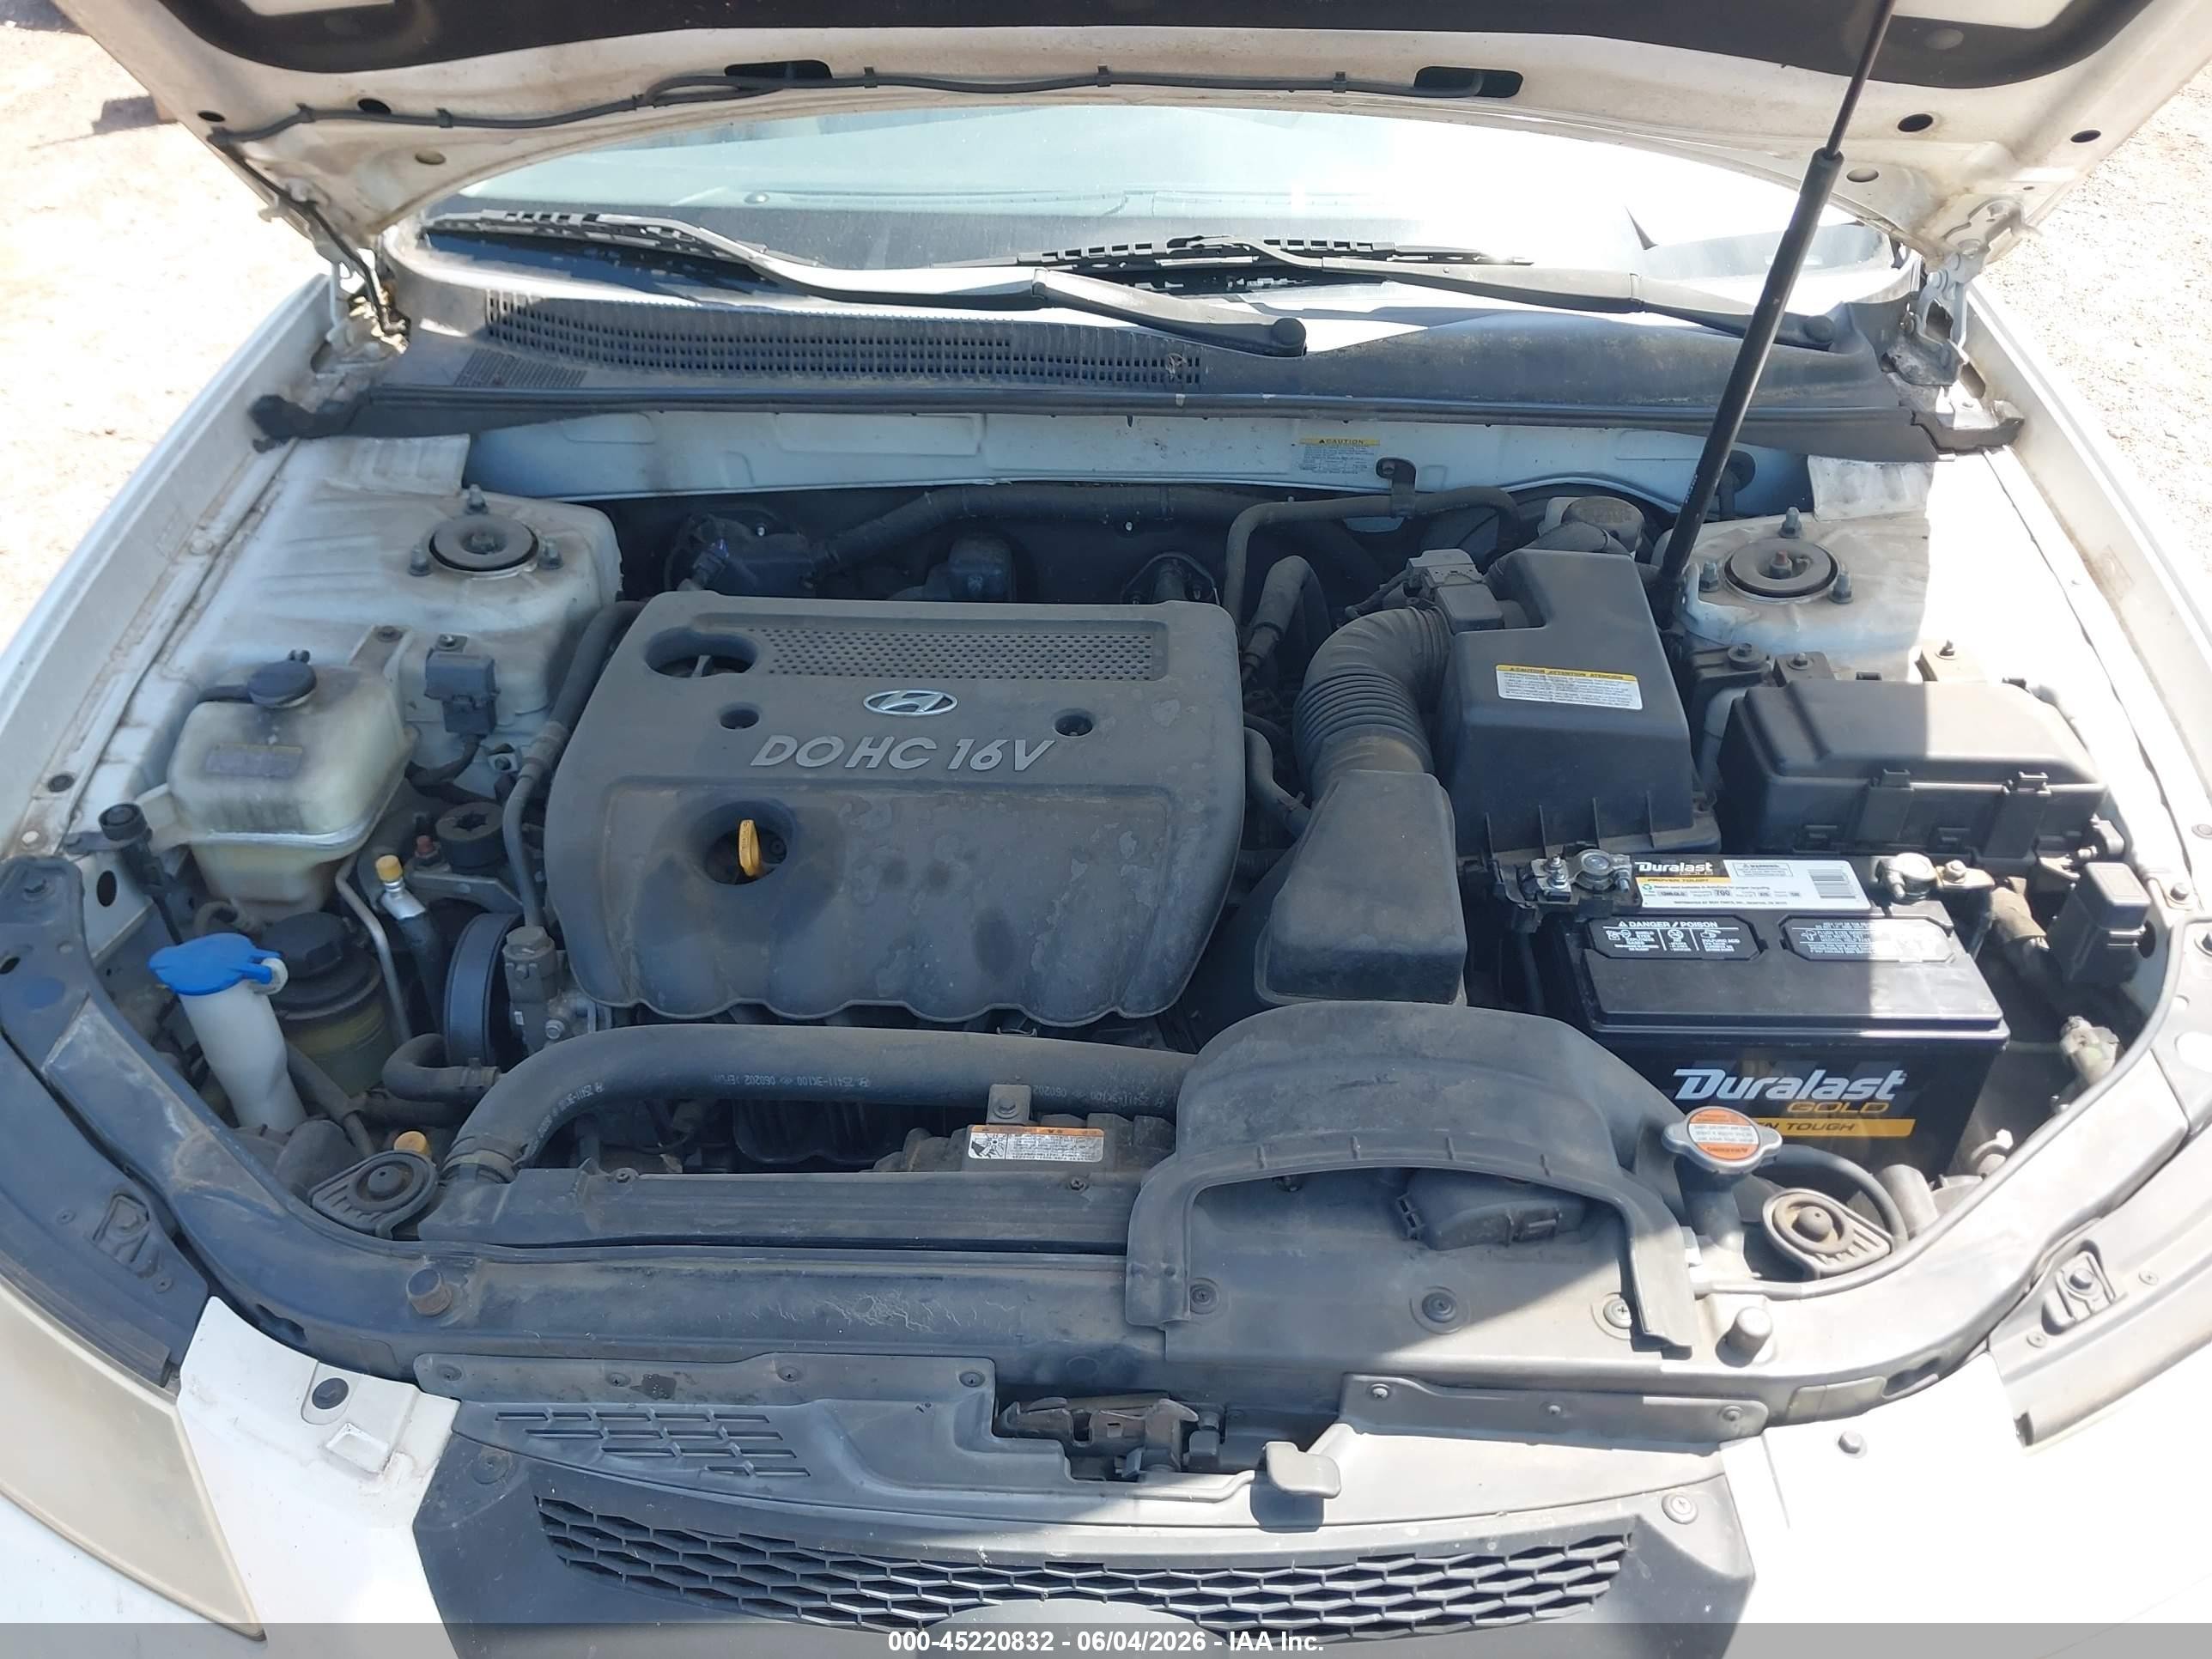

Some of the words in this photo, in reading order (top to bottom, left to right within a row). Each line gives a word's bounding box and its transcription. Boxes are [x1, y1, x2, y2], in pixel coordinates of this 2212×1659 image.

[948, 738, 1055, 771] 16V
[1634, 861, 1712, 872] Duralast
[1673, 1069, 1906, 1100] Duralast
[1786, 1102, 1892, 1114] GOLD
[1787, 1122, 1856, 1132] TOUGH
